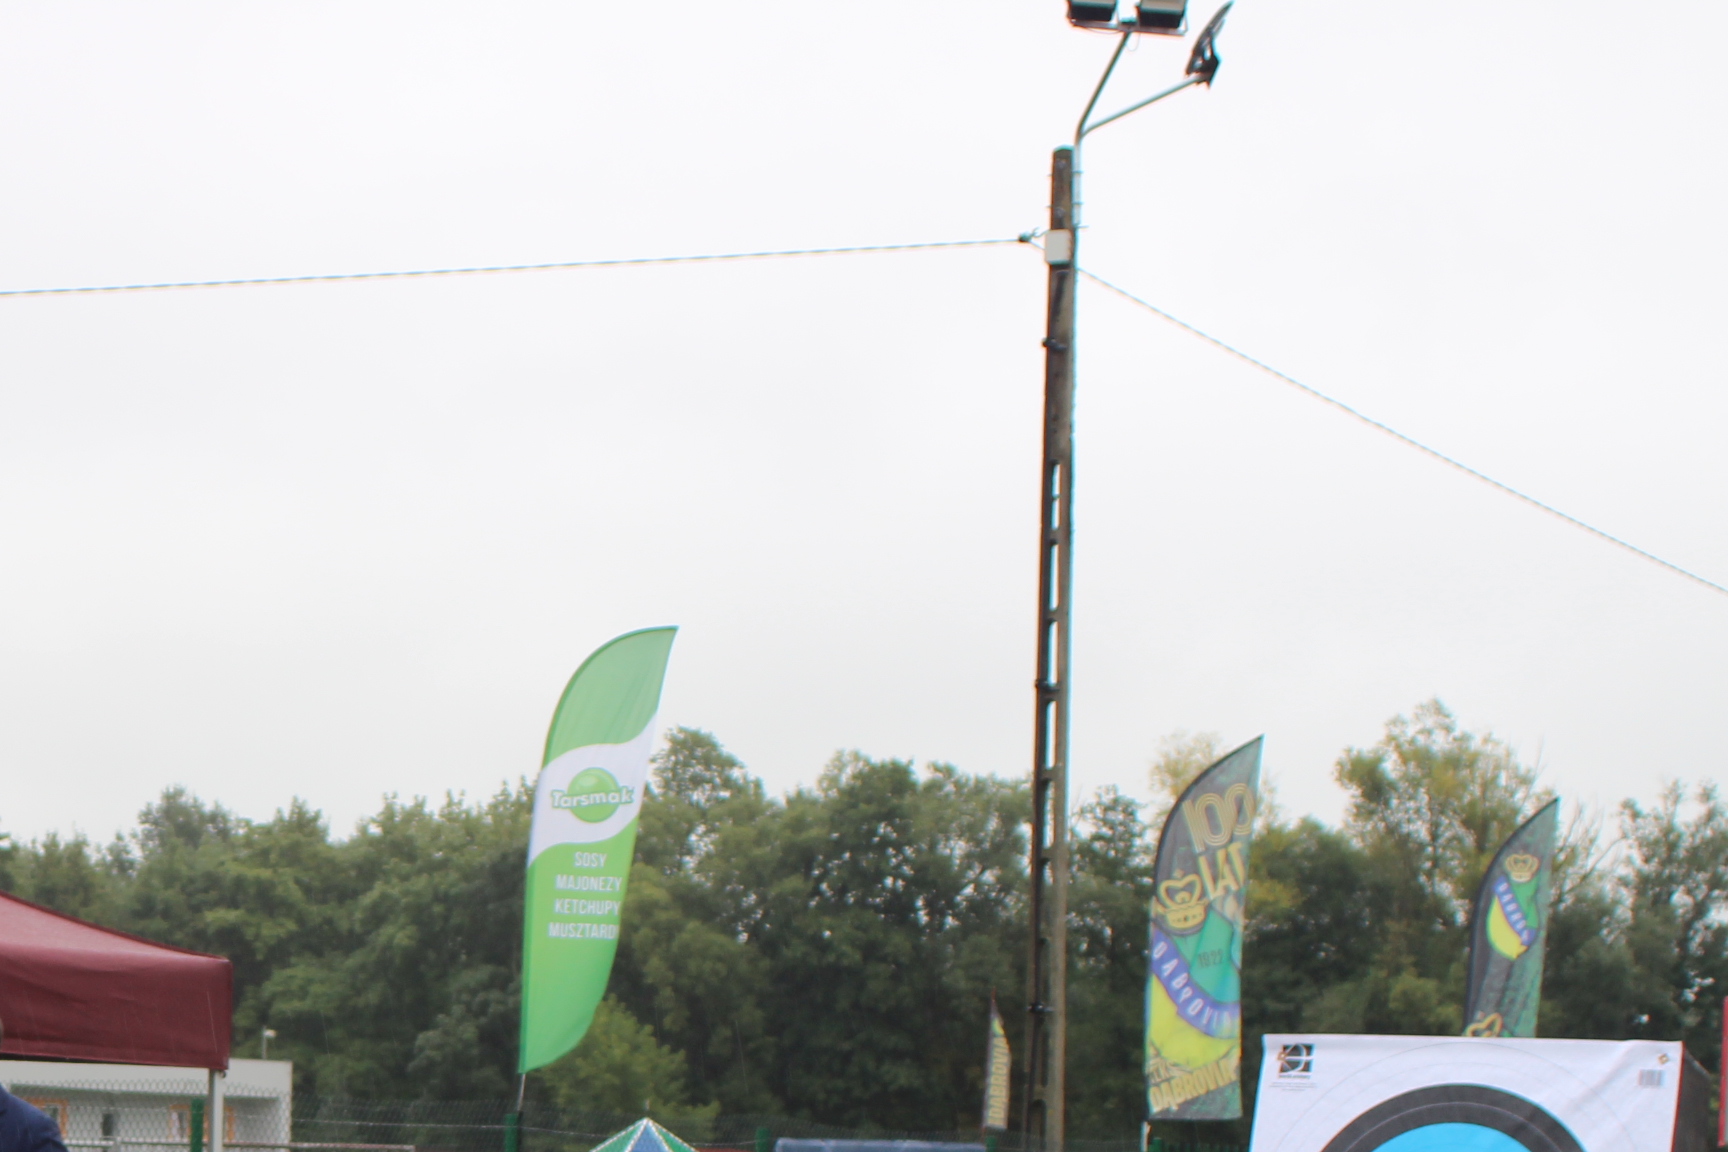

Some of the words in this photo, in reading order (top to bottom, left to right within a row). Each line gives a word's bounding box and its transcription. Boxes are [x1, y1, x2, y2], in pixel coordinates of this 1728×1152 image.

[552, 786, 634, 809] Tarsmak
[1182, 783, 1255, 853] 100
[574, 851, 607, 868] SOSY
[1198, 842, 1246, 900] LAT
[557, 874, 623, 893] MAJONEZY
[554, 898, 621, 916] KETCHUPY
[548, 922, 619, 940] MUSZTARD
